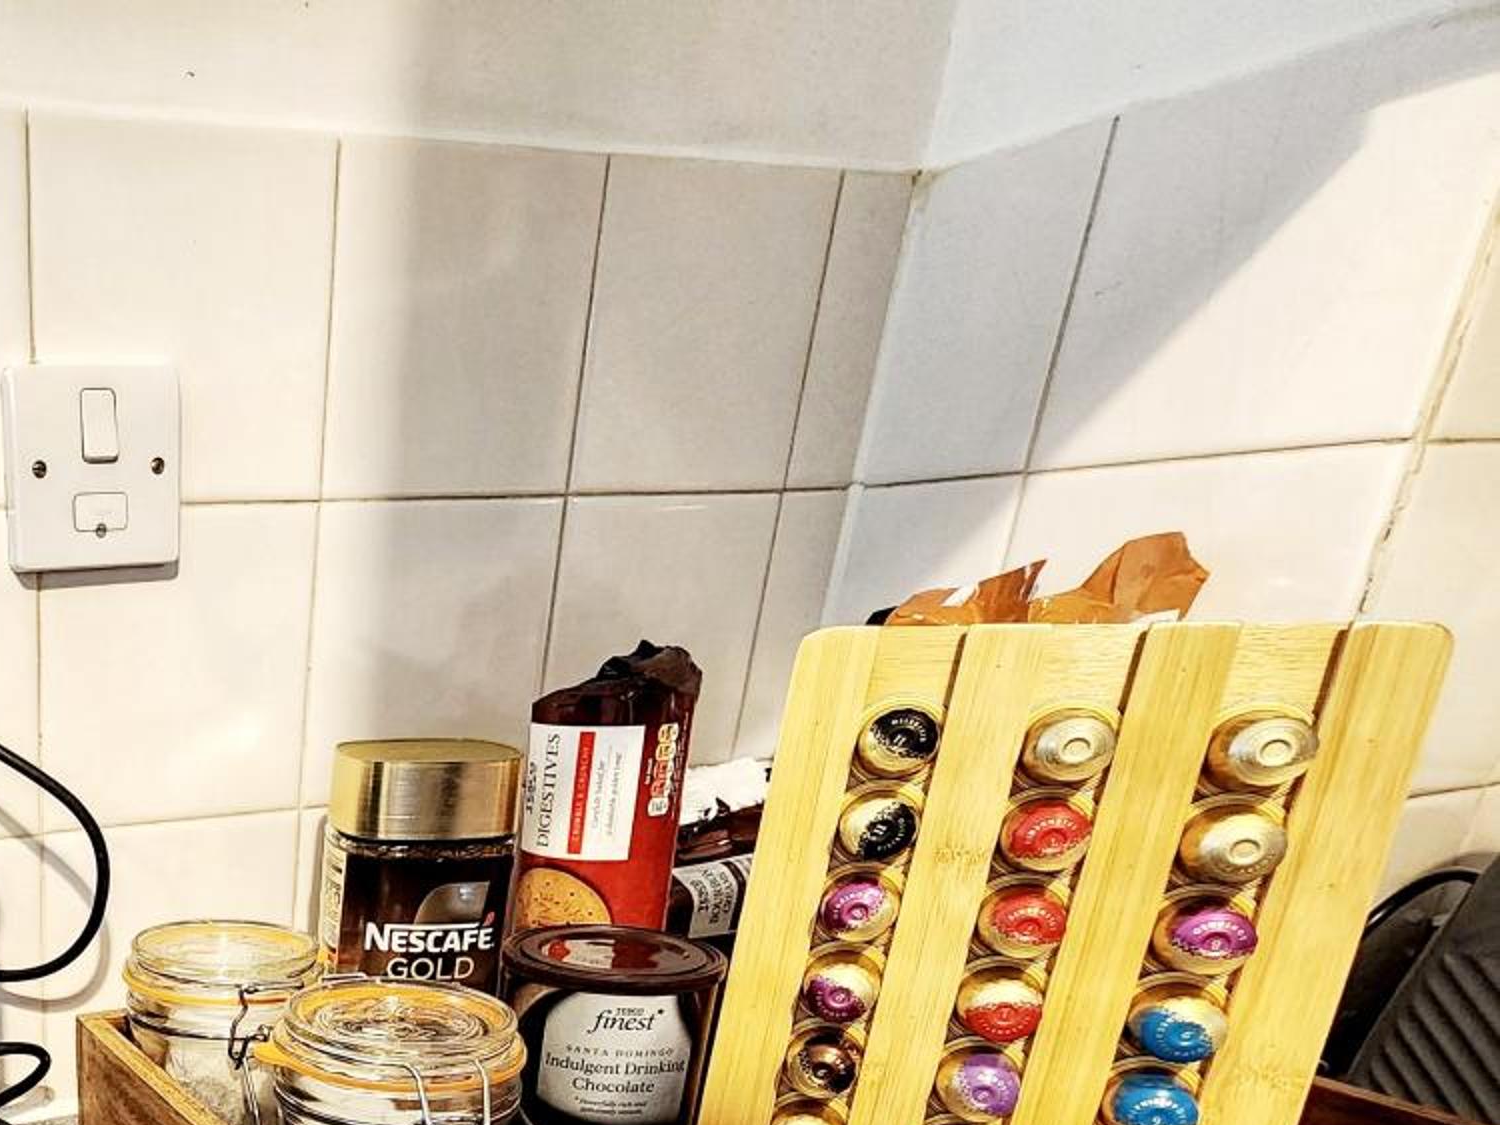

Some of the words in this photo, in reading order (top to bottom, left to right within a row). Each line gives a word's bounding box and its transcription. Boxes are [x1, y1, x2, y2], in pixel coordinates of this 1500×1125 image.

[536, 733, 561, 848] DIGESTIVES
[387, 957, 475, 981] GOLD
[566, 1045, 609, 1057] SANTA
[545, 1052, 619, 1076] Indulgent
[572, 1077, 655, 1093] Chocolate
